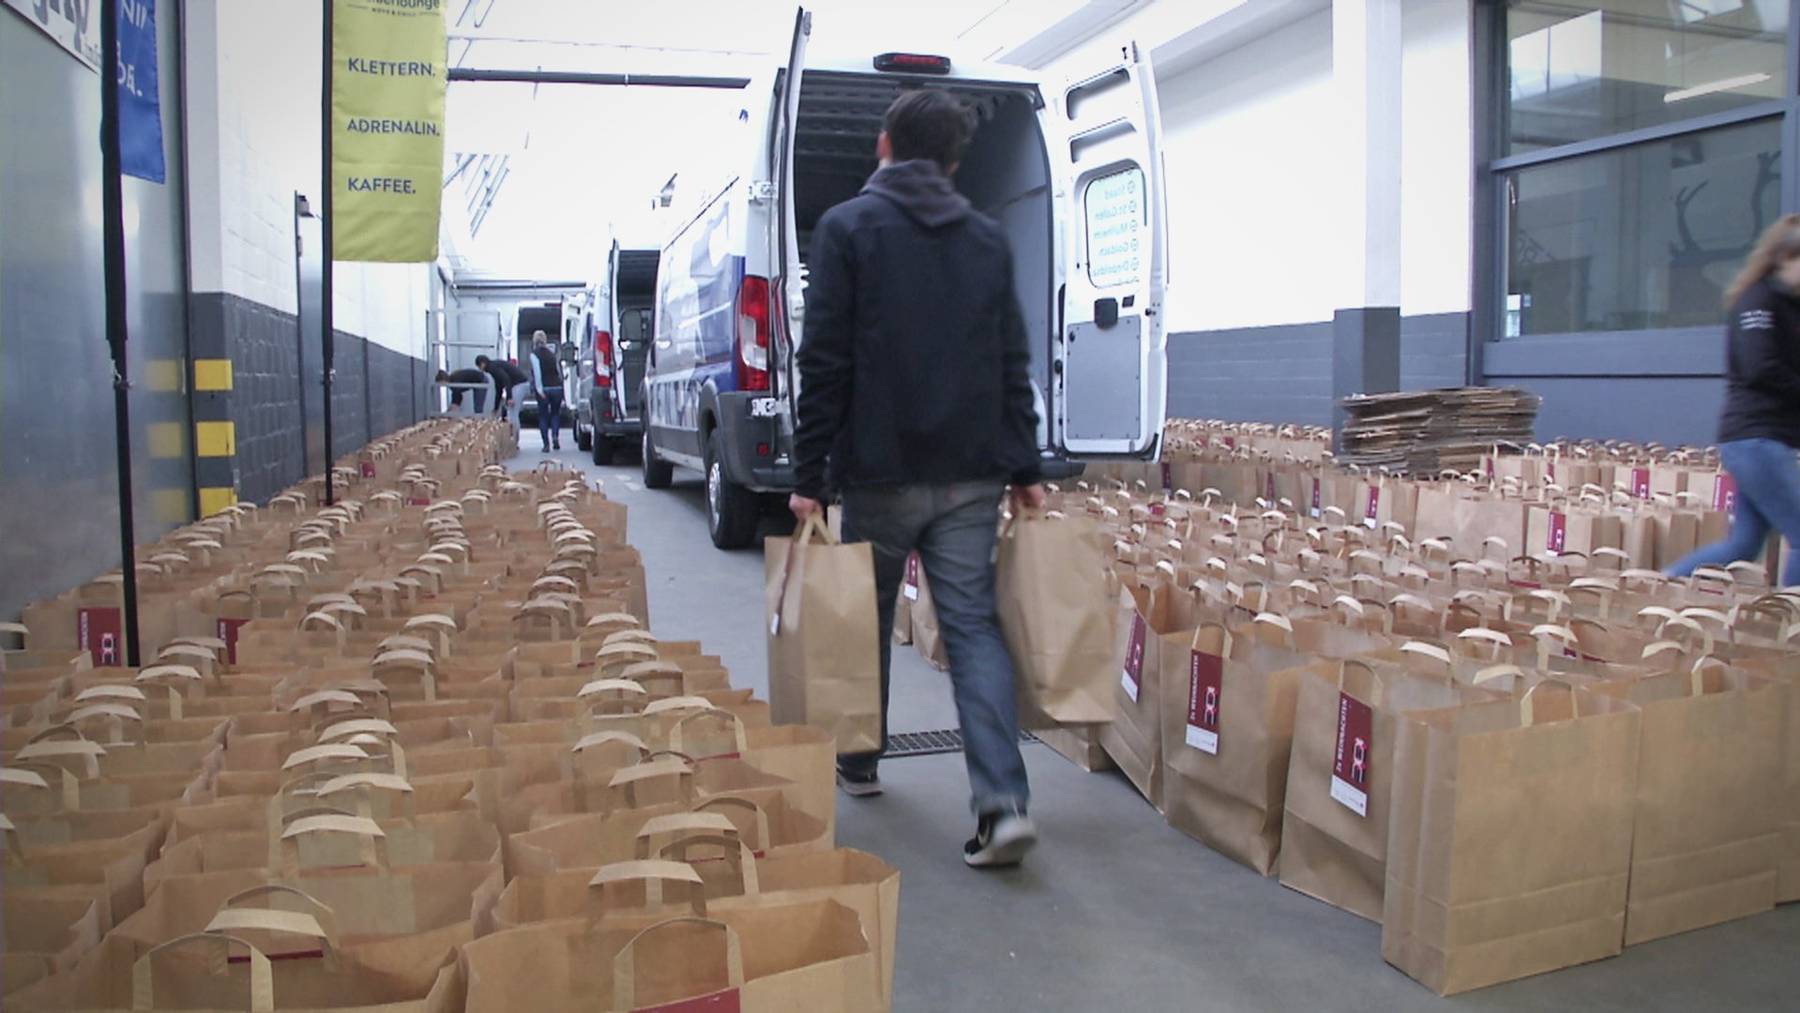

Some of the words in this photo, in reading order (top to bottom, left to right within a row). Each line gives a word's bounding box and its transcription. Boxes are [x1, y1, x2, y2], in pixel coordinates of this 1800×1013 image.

[348, 58, 436, 77] KLETTERN.
[347, 118, 440, 137] ADRENALIN.
[348, 177, 416, 195] KAFFEE.
